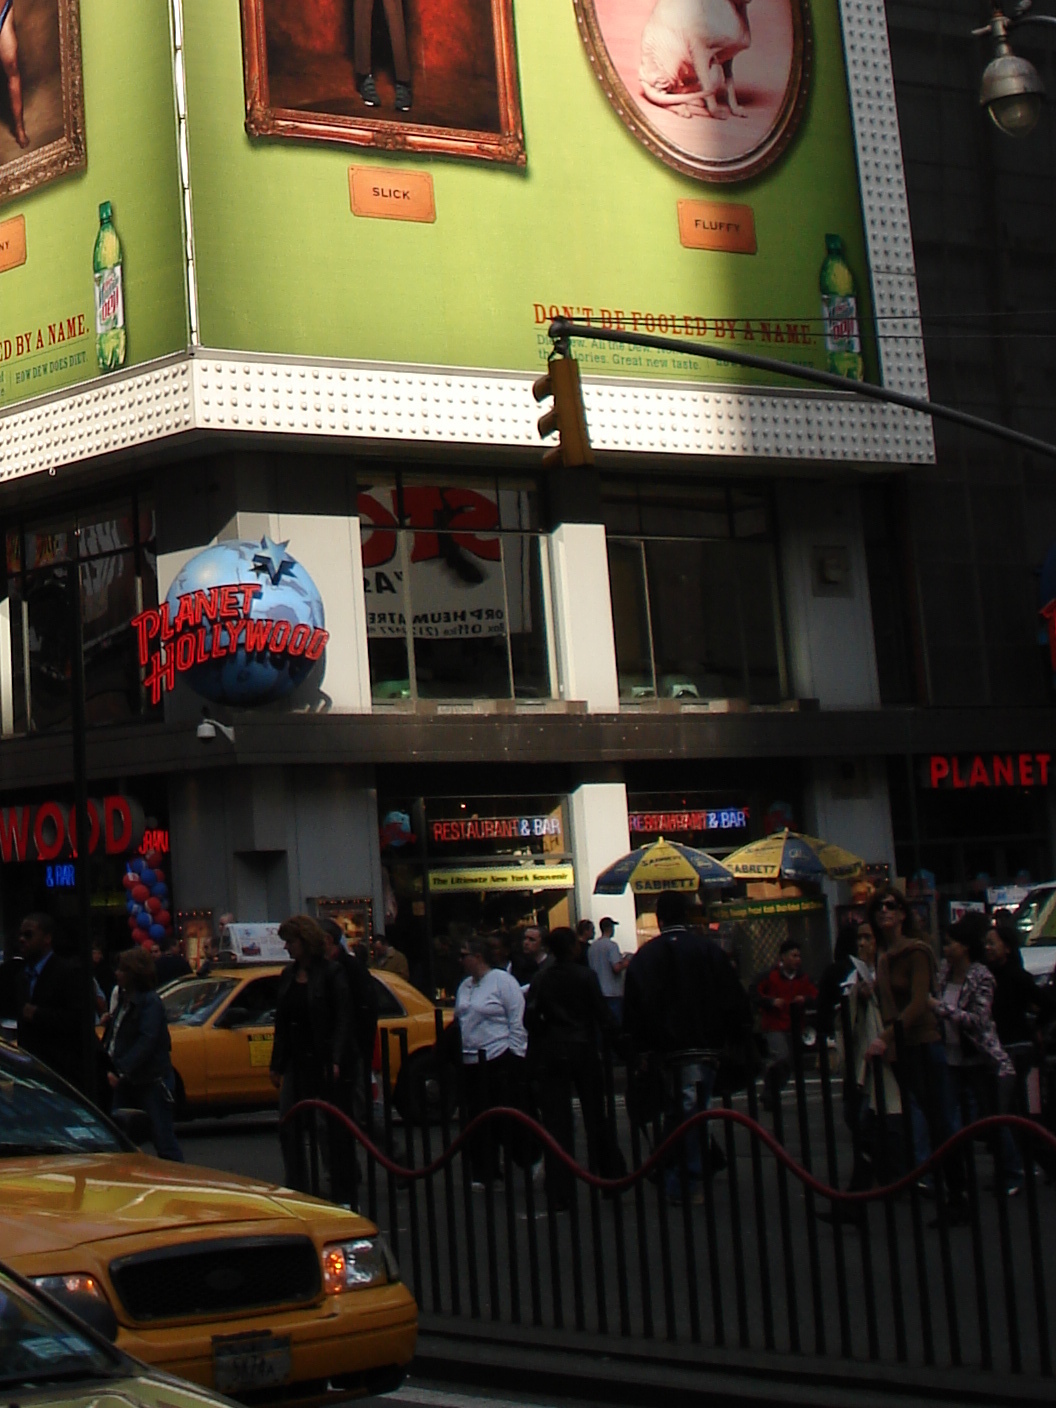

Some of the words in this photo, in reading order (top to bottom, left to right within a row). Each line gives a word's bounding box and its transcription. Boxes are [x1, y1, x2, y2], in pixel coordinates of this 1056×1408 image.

[372, 187, 411, 200] SLICK
[694, 218, 741, 233] FLUFFY
[16, 332, 32, 356] BY
[36, 328, 44, 350] A
[48, 313, 90, 346] NAME.
[533, 304, 593, 327] DON'T
[600, 309, 625, 331] BE
[631, 311, 707, 336] FOOLED
[714, 319, 736, 339] BY
[744, 321, 755, 340] A
[760, 322, 817, 344] NAME.
[613, 353, 642, 366] Great
[646, 357, 668, 368] new
[131, 583, 262, 667] PLANET
[144, 619, 330, 706] HOLLYWOOD
[929, 752, 1051, 789] PLANET
[433, 818, 519, 841] RESTAURANT
[521, 819, 531, 836] &
[533, 818, 561, 835] BAR
[708, 813, 718, 829] &
[720, 810, 746, 829] BAR
[45, 864, 54, 888] &
[433, 877, 447, 885] The
[451, 876, 487, 884] Ultimate
[511, 874, 529, 882] York
[532, 873, 568, 881] Souvenir
[635, 878, 695, 891] SABRETT
